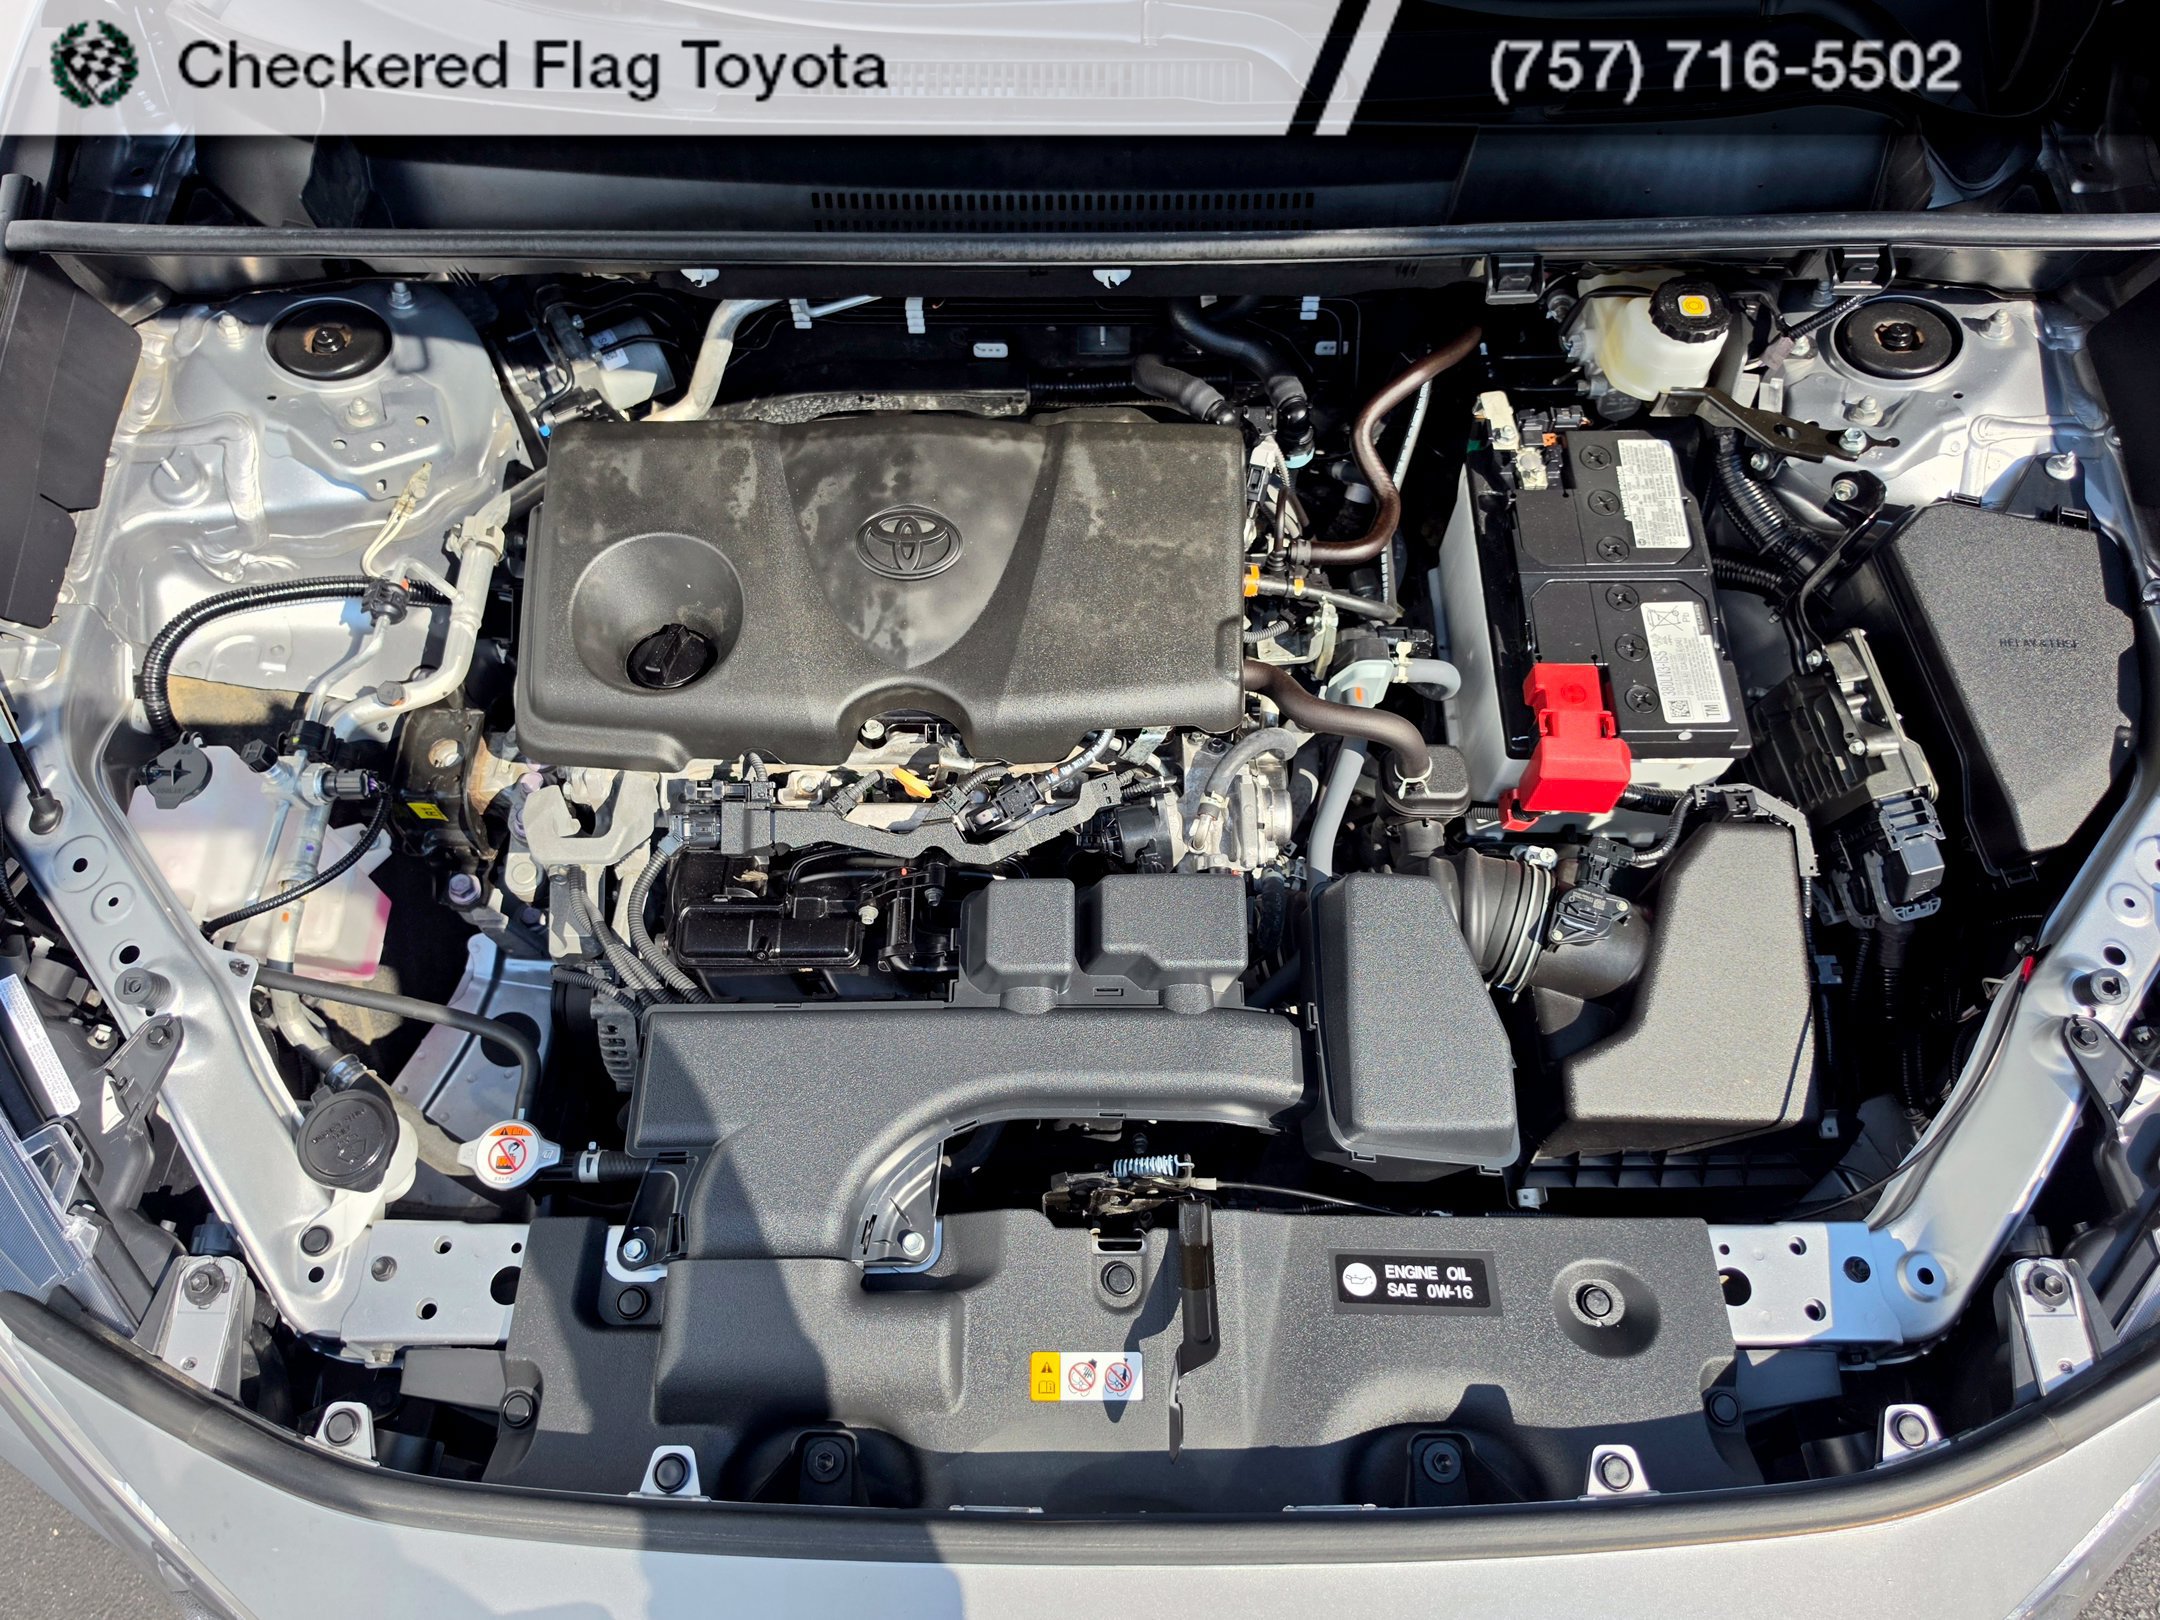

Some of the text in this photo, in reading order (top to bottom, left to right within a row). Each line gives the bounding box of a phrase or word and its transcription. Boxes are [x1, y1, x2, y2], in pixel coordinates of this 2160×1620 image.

[1653, 650, 1676, 697] 380LN3-ISS
[1704, 703, 1721, 718] TM
[1384, 1264, 1473, 1282] ENGINE OIL
[1387, 1282, 1474, 1300] SAE 0W-16
